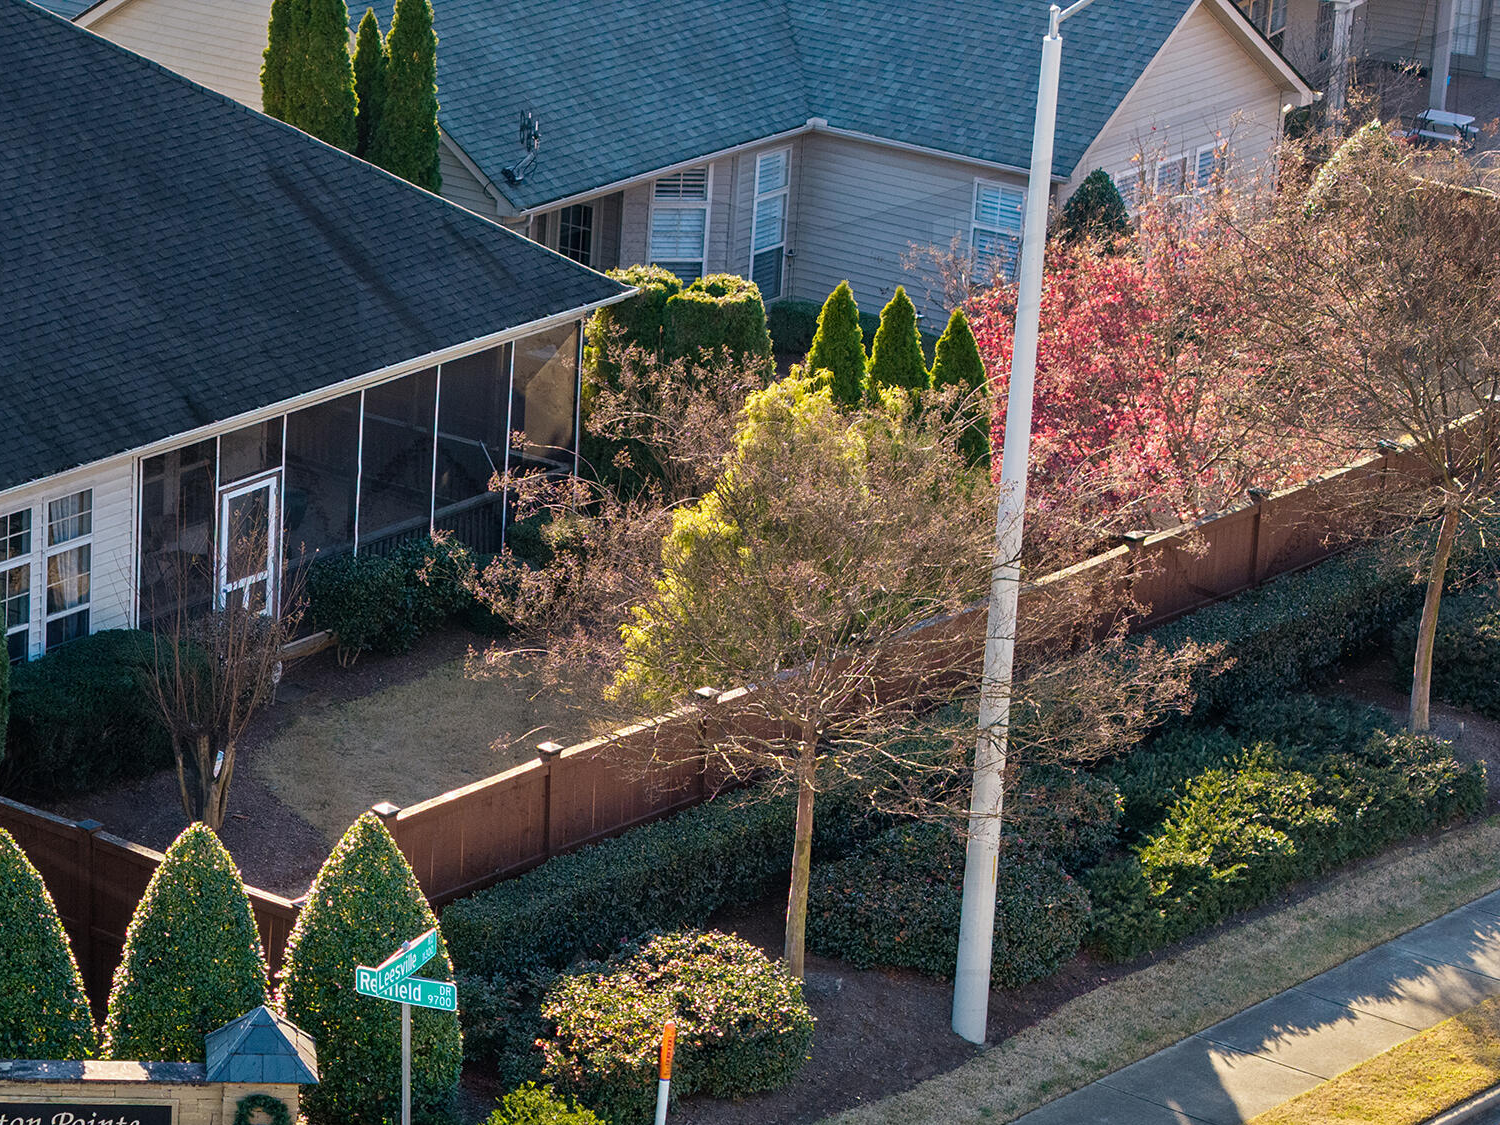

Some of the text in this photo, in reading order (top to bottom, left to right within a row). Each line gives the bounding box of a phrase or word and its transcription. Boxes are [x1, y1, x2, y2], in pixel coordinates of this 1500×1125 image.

[378, 952, 417, 991] Leesville
[439, 986, 452, 997] DR
[427, 994, 452, 1008] 9700
